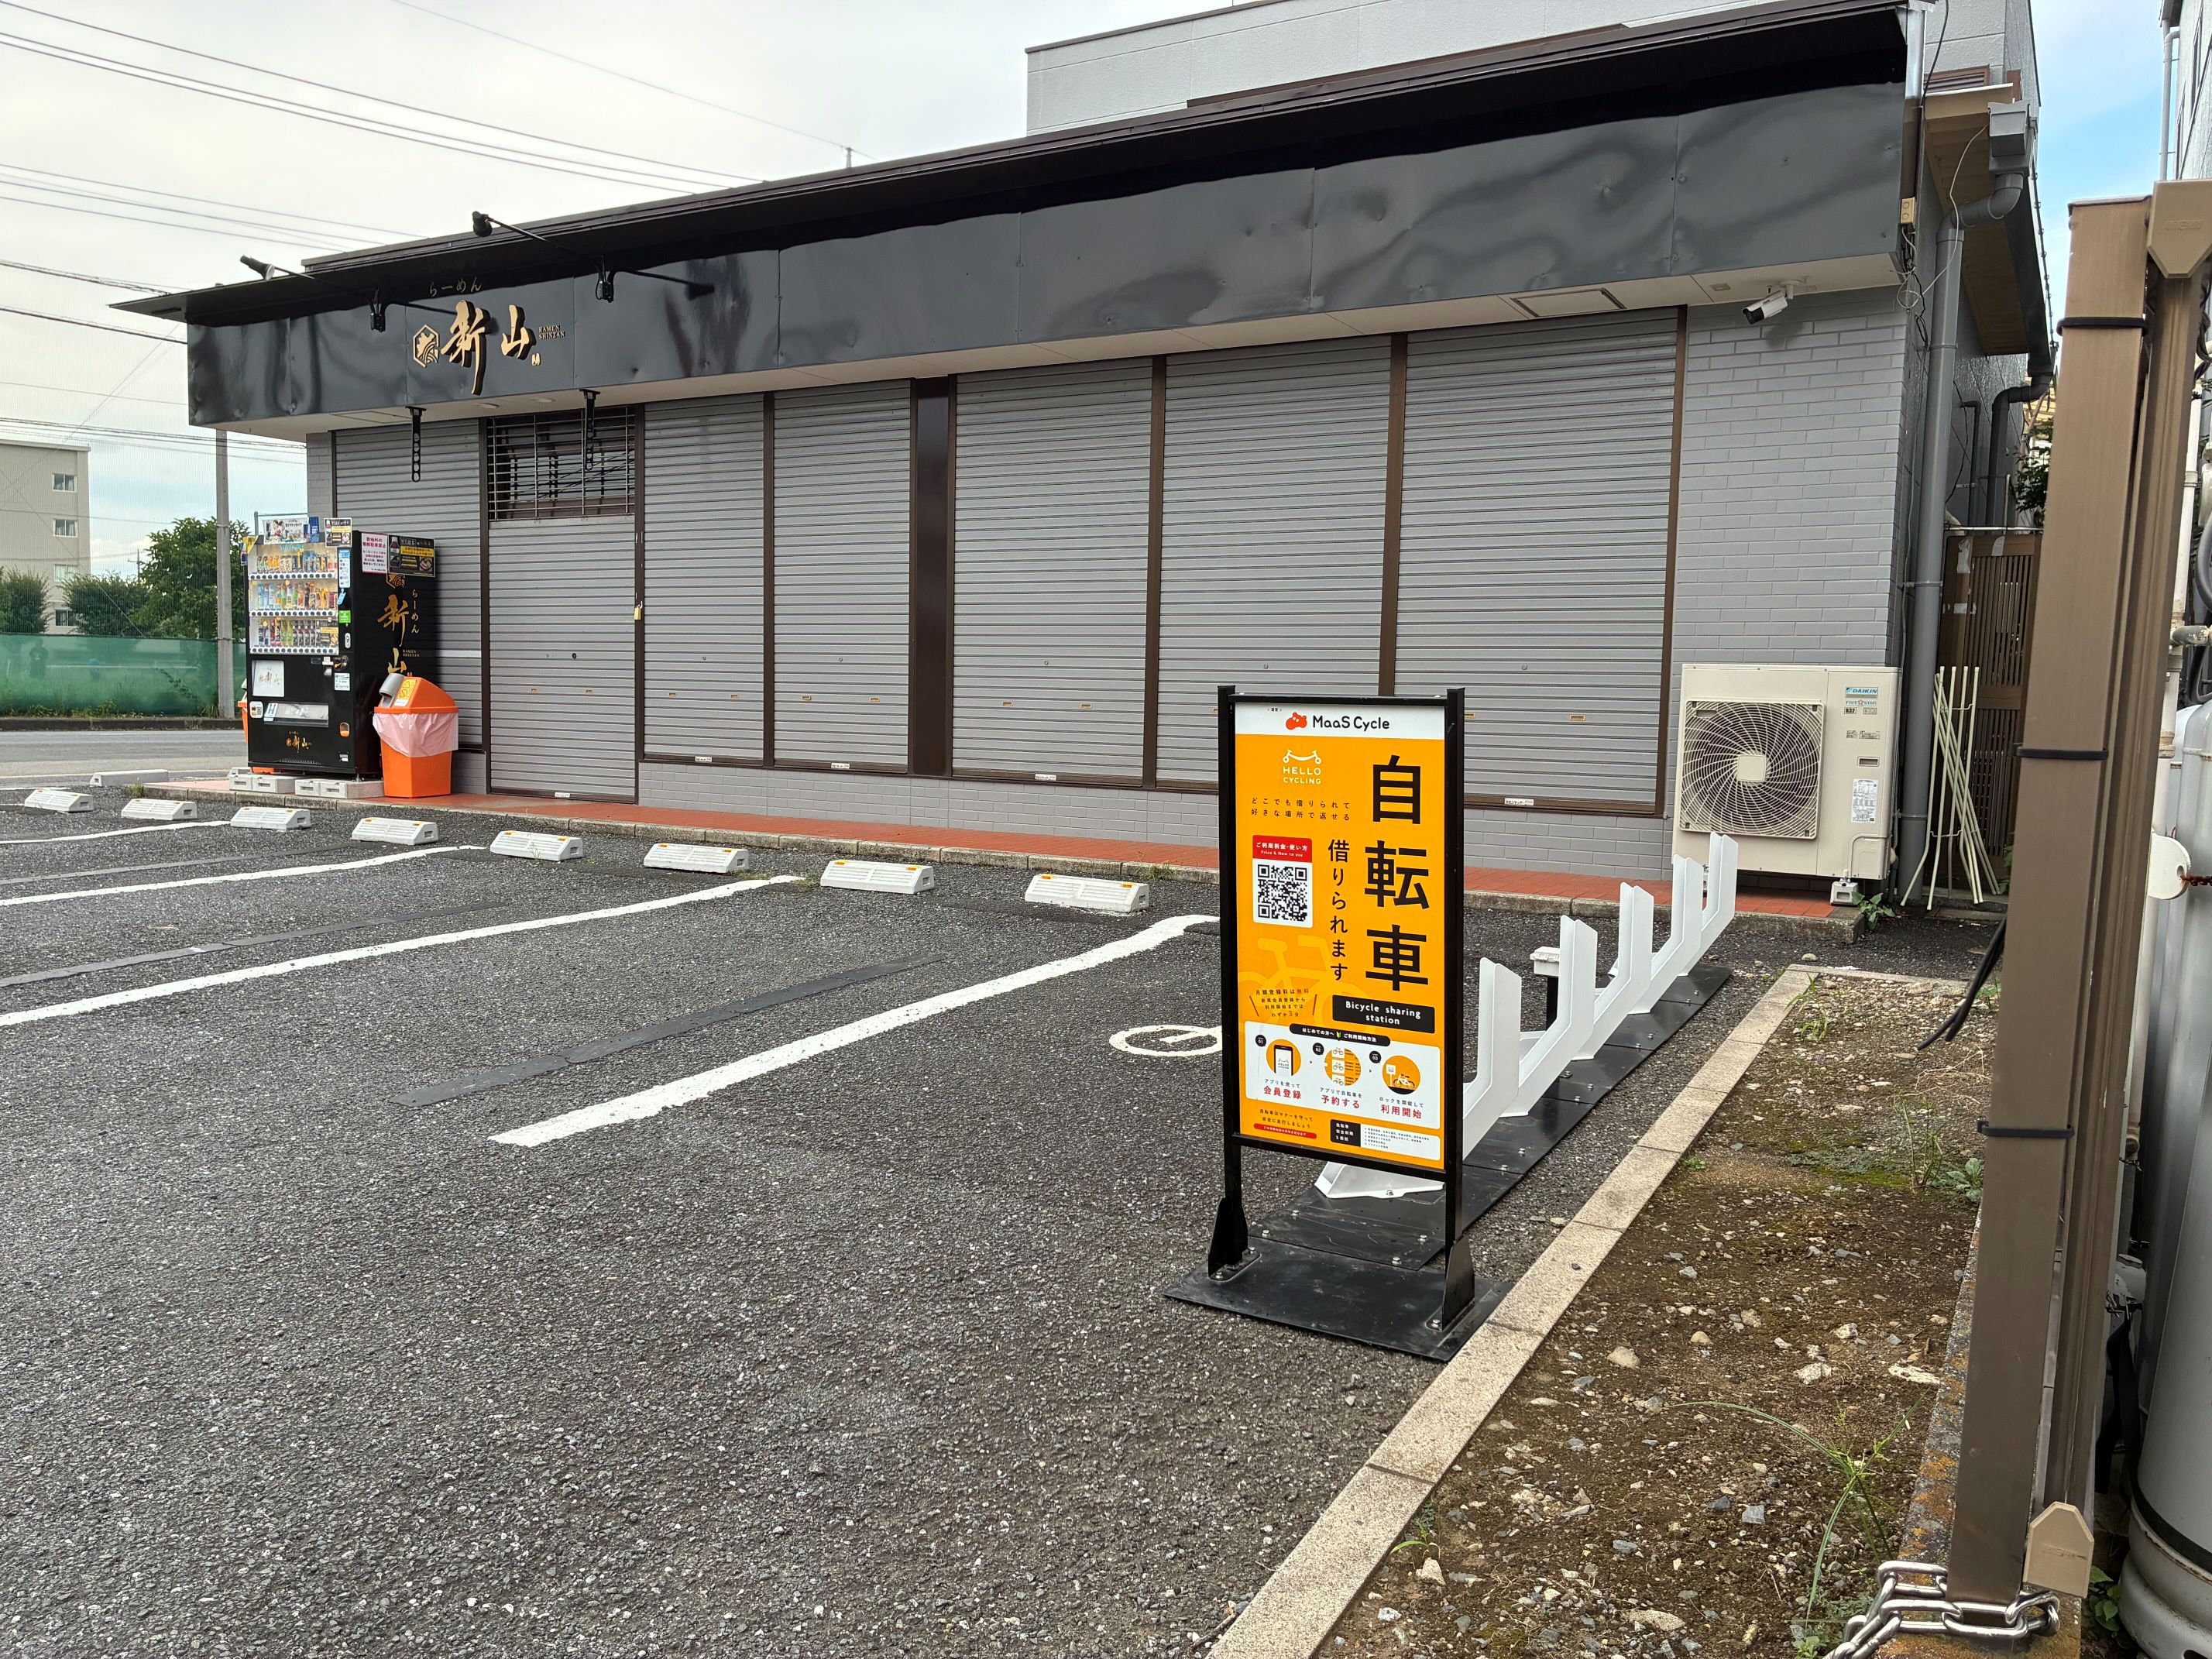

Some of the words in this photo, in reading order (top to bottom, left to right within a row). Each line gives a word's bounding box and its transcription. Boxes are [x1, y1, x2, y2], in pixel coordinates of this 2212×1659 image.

[429, 276, 482, 297] らーめん
[538, 325, 560, 333] RAMEN
[538, 331, 565, 340] SHINZAN
[441, 300, 533, 395] 新山
[410, 589, 420, 634] らーめん
[1312, 715, 1351, 729] MaaS
[1353, 716, 1390, 731] Cycle
[1283, 766, 1321, 775] HELLO
[1283, 776, 1321, 785] CYCLING
[1251, 797, 1350, 809] どこでも借りられて
[1251, 808, 1350, 821] 好きな場所で返せる
[1365, 754, 1430, 991] 自転車
[1328, 838, 1351, 981] 借りられます
[1345, 1001, 1379, 1012] Bicycle
[1385, 1005, 1421, 1019] sharing
[1365, 1015, 1400, 1025] station
[1263, 1086, 1302, 1099] 会員登録
[1321, 1094, 1360, 1109] 予約する
[1380, 1104, 1422, 1119] 利用開始
